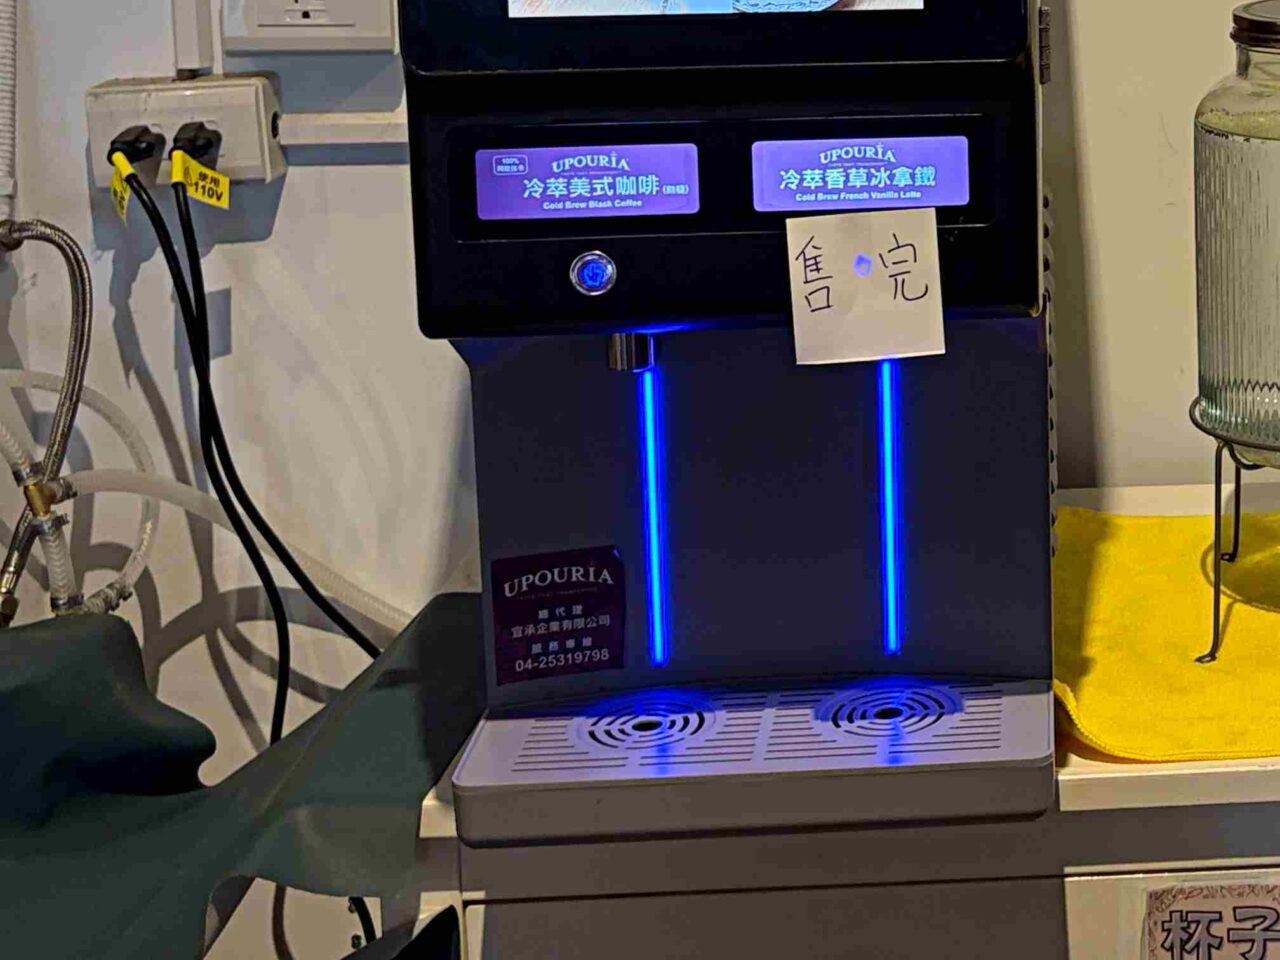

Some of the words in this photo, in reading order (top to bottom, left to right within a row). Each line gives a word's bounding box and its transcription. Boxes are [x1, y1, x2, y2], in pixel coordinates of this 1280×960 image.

[523, 174, 661, 199] 冷萃美式咖啡
[779, 166, 937, 191] 冷萃香草冰拿鐵
[193, 180, 224, 203] 110V
[543, 201, 563, 210] Cold
[565, 200, 587, 209] Brew
[504, 566, 614, 597] UPOURIA
[515, 647, 610, 672] 04-25319798
